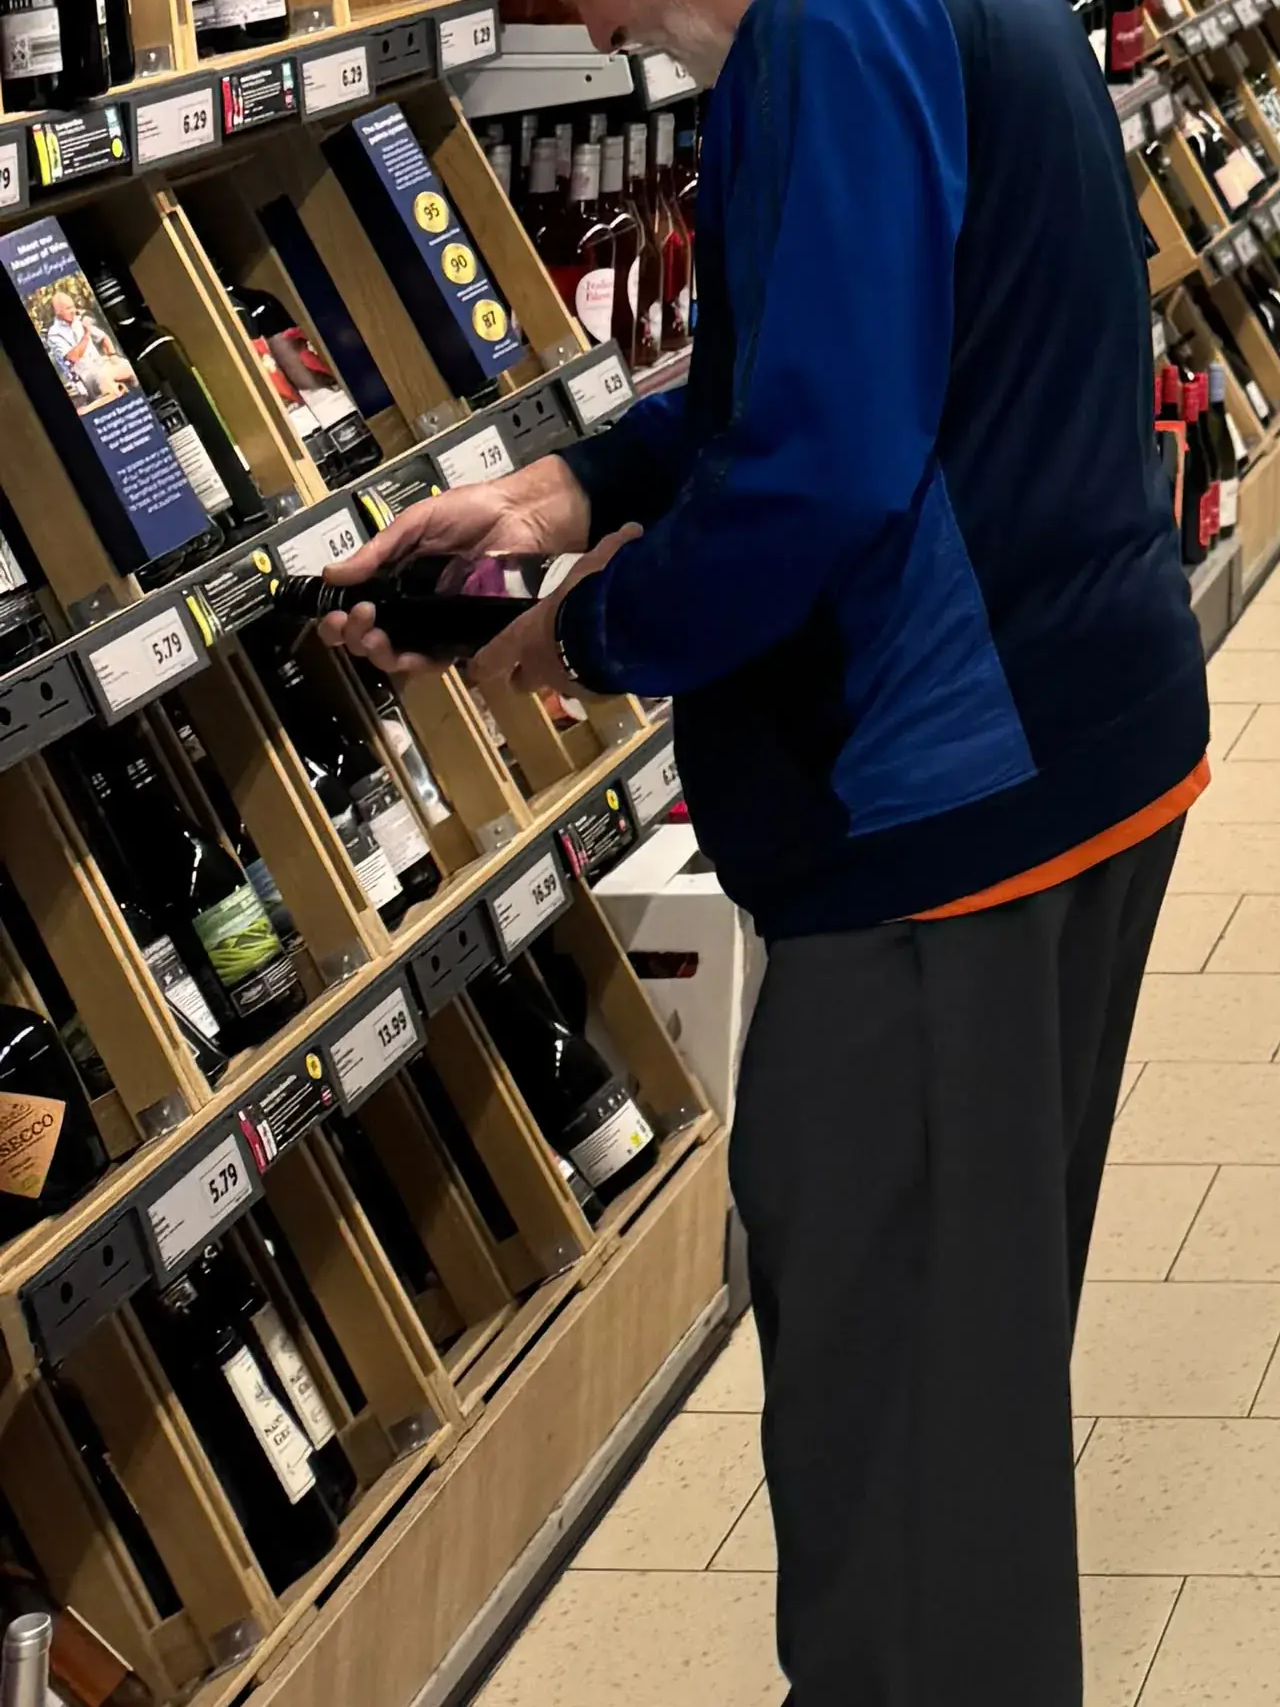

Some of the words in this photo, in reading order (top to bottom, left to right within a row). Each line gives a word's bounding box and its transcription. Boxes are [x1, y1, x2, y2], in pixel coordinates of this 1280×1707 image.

[183, 110, 207, 135] 6.29
[423, 203, 440, 221] 95
[450, 254, 468, 273] 90
[481, 310, 497, 329] 87
[328, 529, 355, 559] 8.49
[151, 632, 184, 667] 5.79
[531, 872, 559, 906] 16.99
[377, 1010, 409, 1049] 13.99
[0, 1114, 54, 1158] SECCO
[209, 1162, 240, 1205] 5.79
